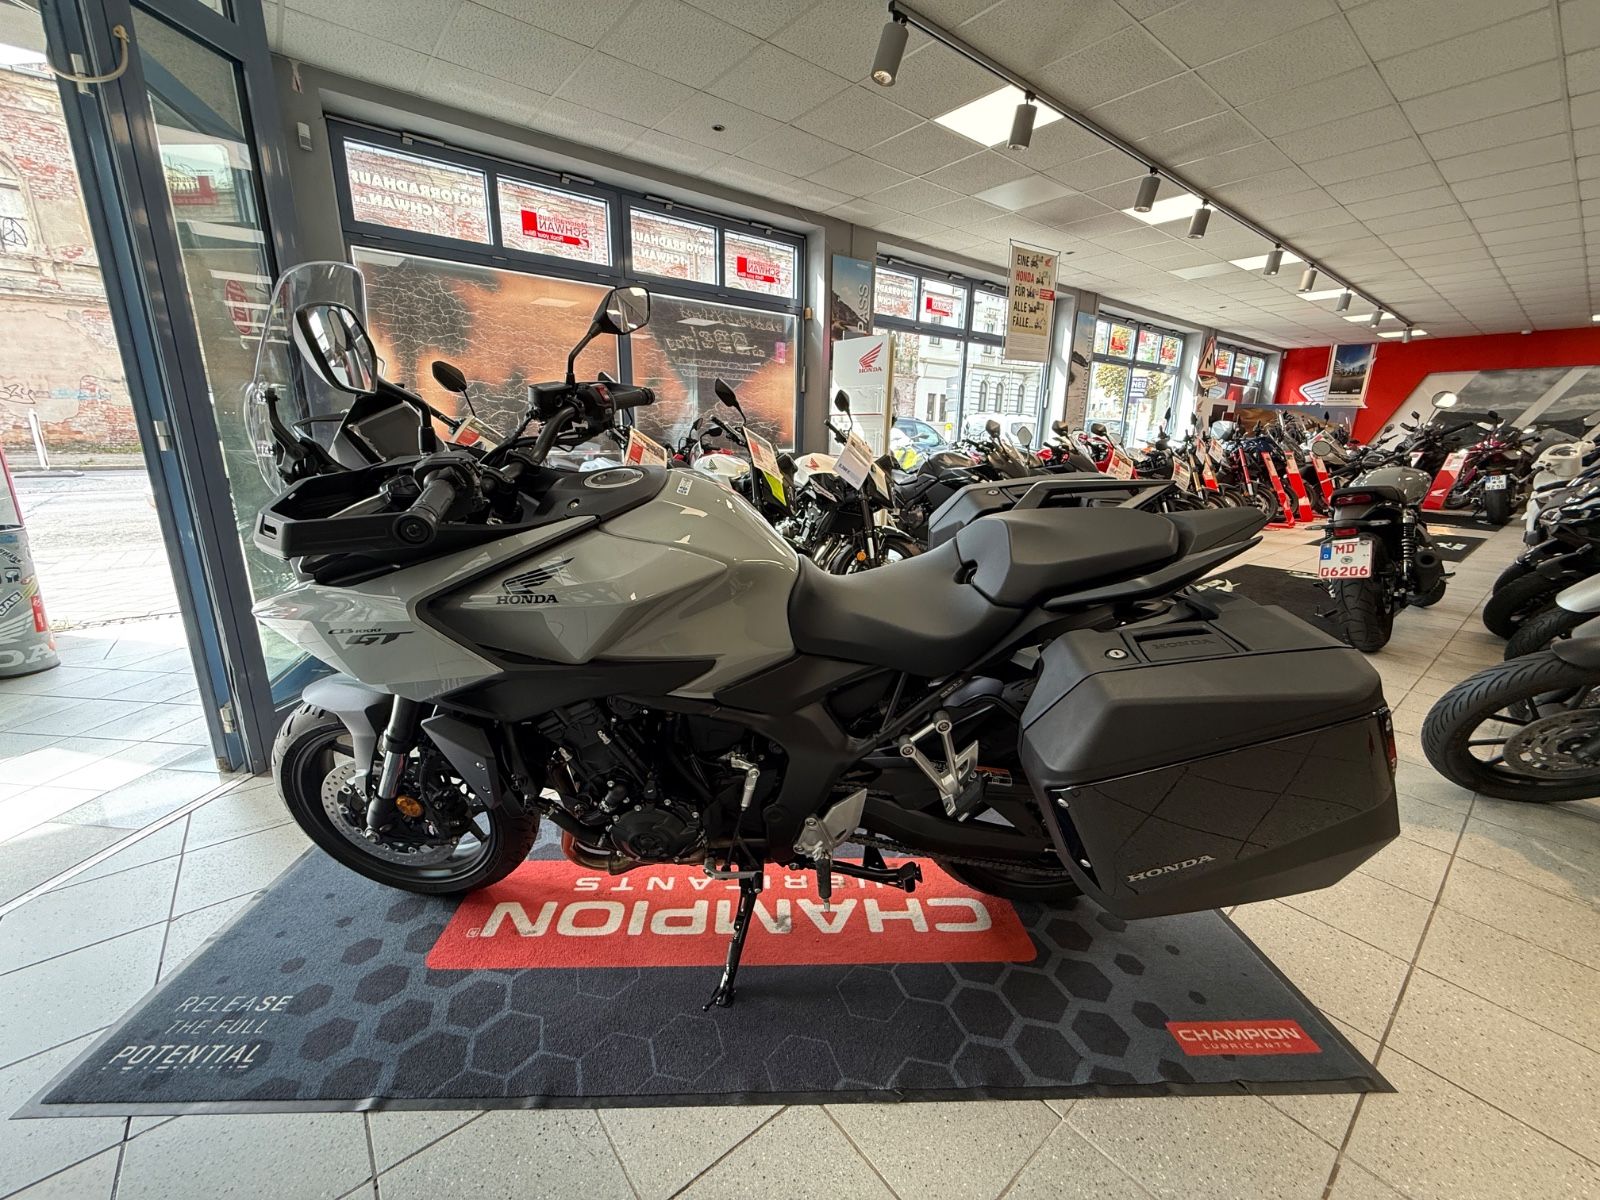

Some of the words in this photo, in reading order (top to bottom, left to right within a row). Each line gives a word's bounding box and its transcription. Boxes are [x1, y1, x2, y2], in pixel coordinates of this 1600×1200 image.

[1017, 254, 1030, 267] EINE
[1015, 270, 1035, 284] HONDA
[1014, 283, 1026, 297] FÜR
[857, 283, 869, 333] PASS
[1013, 301, 1028, 313] ALLE
[1335, 543, 1355, 554] MD
[1320, 566, 1368, 577] 06206
[496, 594, 559, 605] HONDA
[345, 630, 415, 646] GT
[1127, 854, 1216, 883] HONDA
[480, 897, 992, 938] CHAMPION
[174, 995, 293, 1012] RELEASE
[165, 1019, 213, 1034] THE
[212, 1019, 269, 1034] FULL
[1177, 1027, 1303, 1042] CHAMPION
[101, 1043, 261, 1070] POTENTIAL
